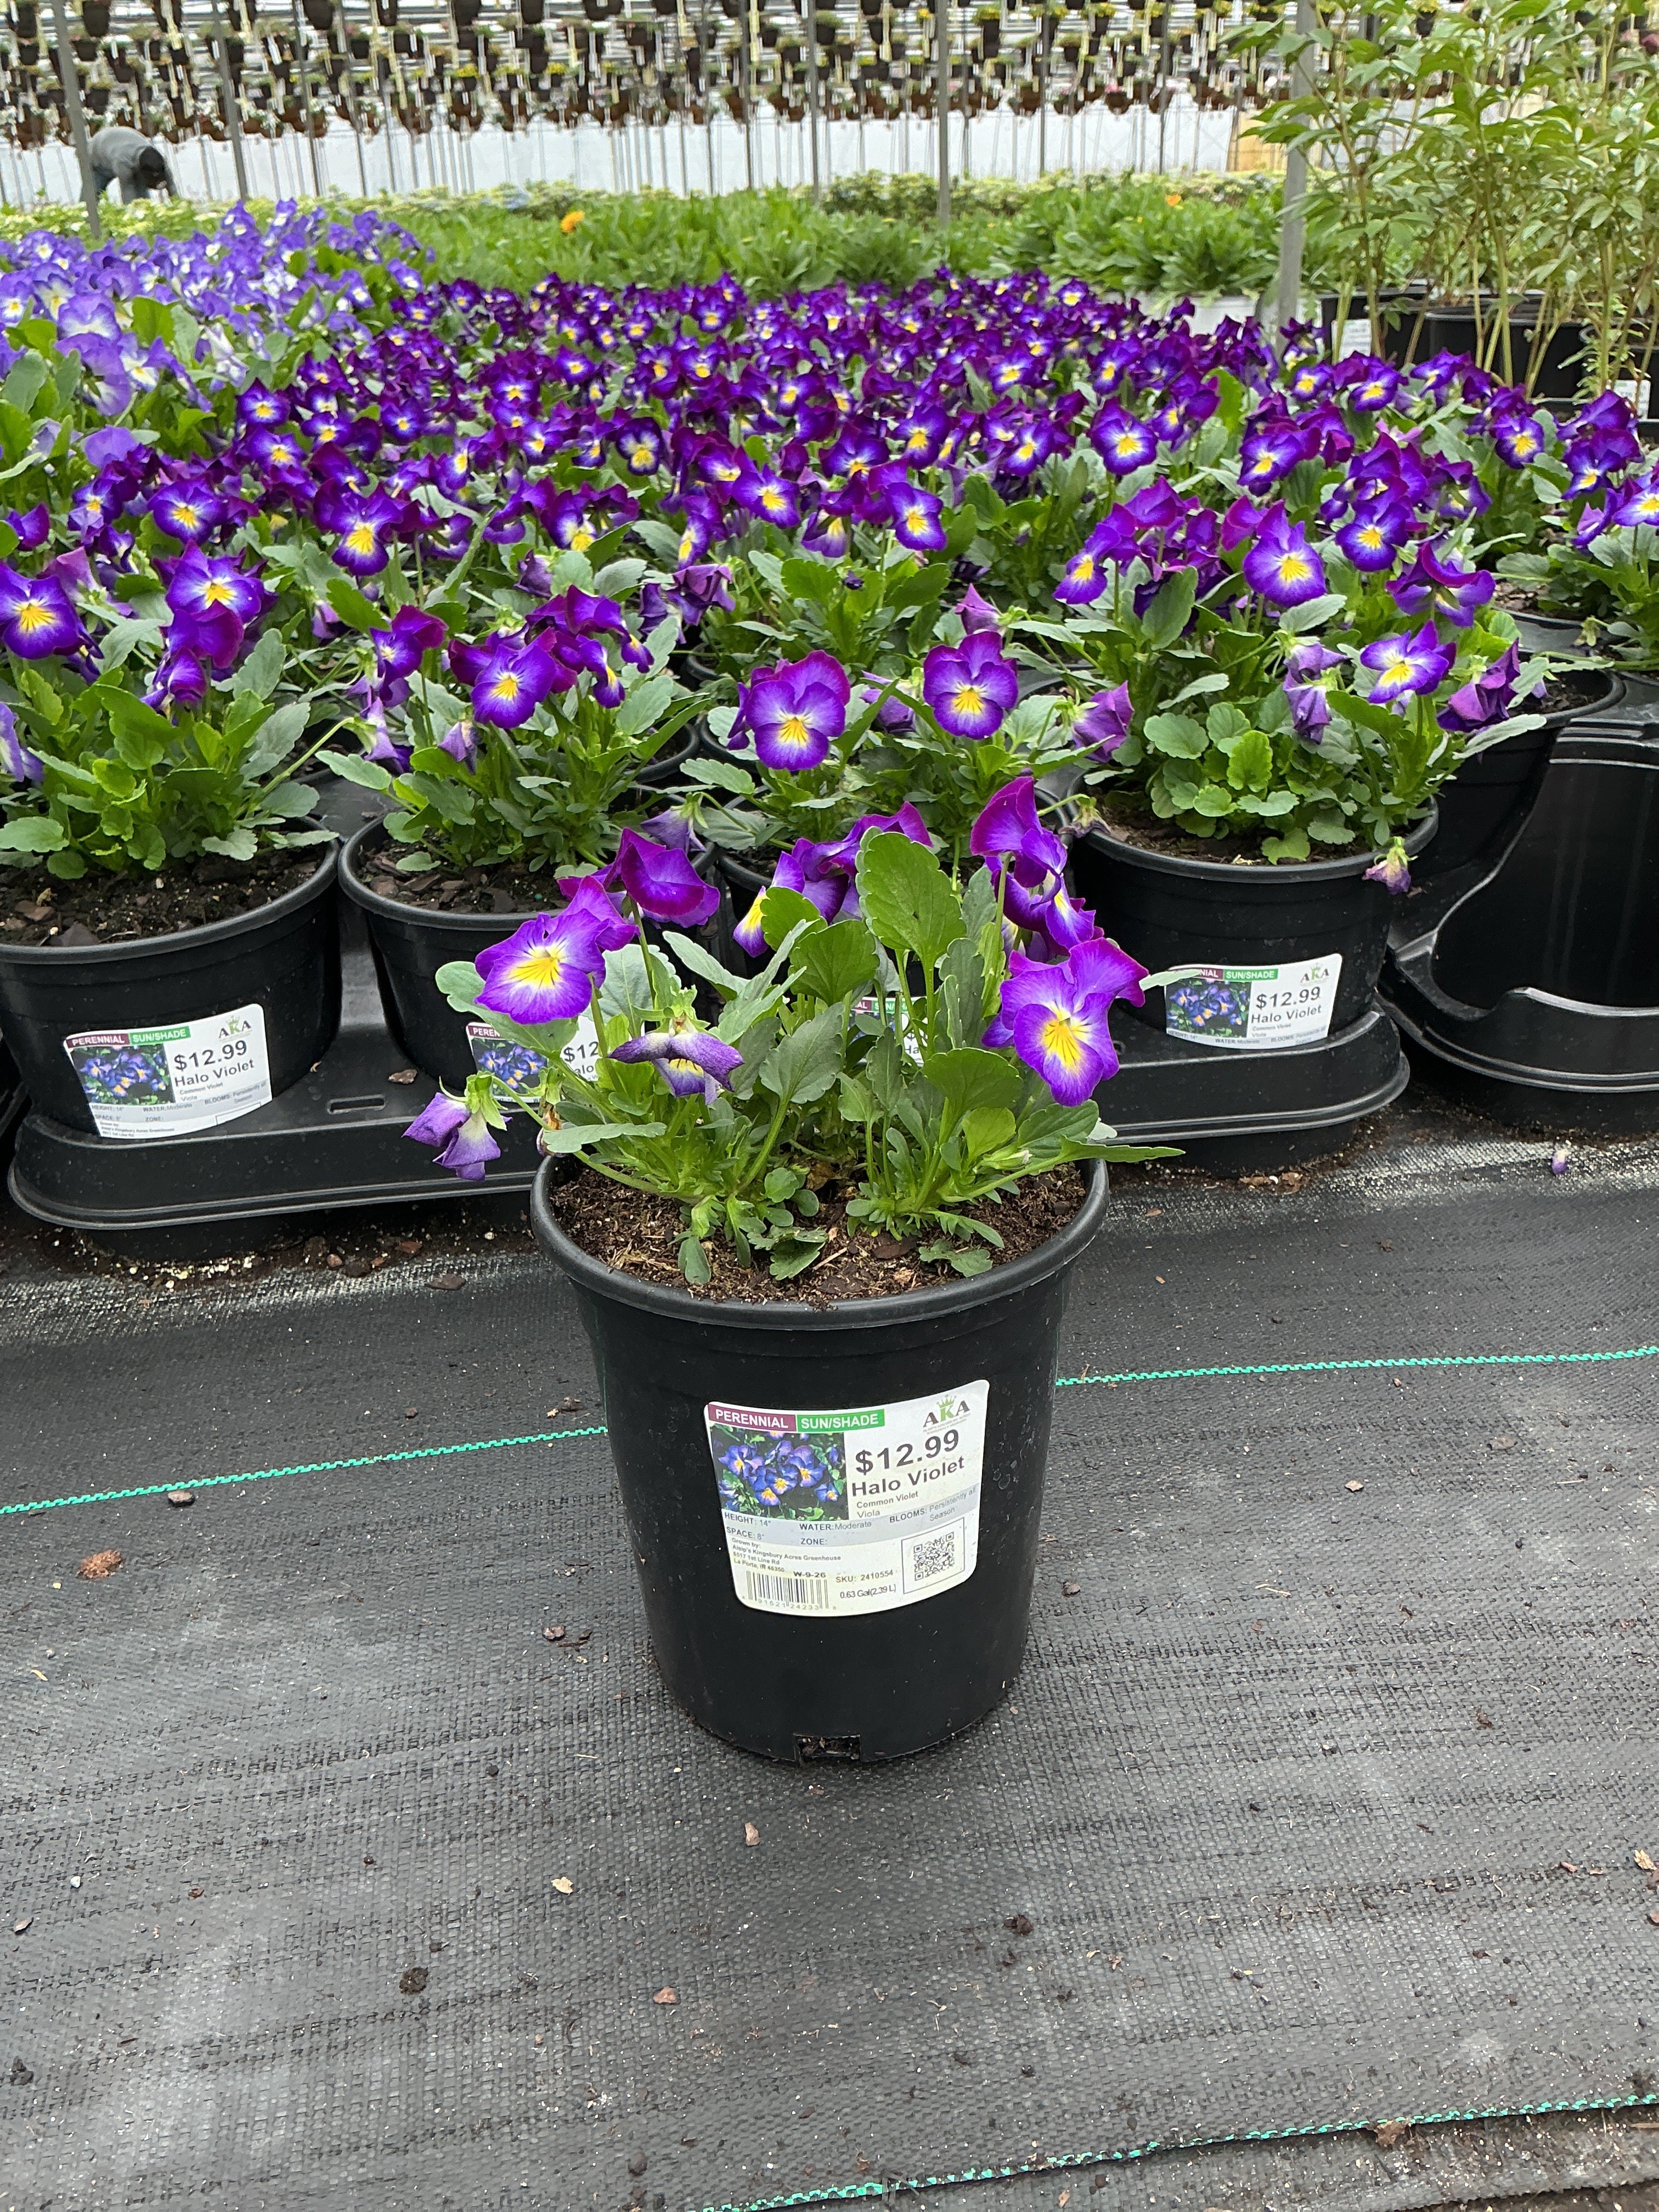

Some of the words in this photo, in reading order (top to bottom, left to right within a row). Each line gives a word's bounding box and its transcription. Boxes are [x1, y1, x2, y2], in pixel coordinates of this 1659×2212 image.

[1226, 971, 1274, 980] SUN/SHADE
[1300, 968, 1329, 984] AKA
[1255, 986, 1321, 1011] $12.99
[1251, 1013, 1282, 1024] Halo
[1286, 1006, 1322, 1020] Violet
[72, 1035, 125, 1046] PERENNIAL
[132, 1029, 187, 1042] SUN/SHADE
[218, 1020, 252, 1039] AKA
[473, 1027, 500, 1037] PEREN
[174, 1040, 247, 1071] $12.99
[563, 1042, 599, 1063] $12
[174, 1074, 209, 1087] Halo
[213, 1059, 255, 1079] Violet
[575, 1064, 594, 1076] alo
[179, 1086, 206, 1095] Common
[207, 1082, 223, 1090] Violet
[715, 1409, 789, 1429] PERENNIAL
[801, 1413, 879, 1429] SUN/SHADE
[923, 1400, 970, 1427] AKA
[855, 1429, 959, 1476] $12.99
[852, 1479, 901, 1497] Halo
[907, 1455, 964, 1486] Violet
[856, 1497, 894, 1509] Common
[896, 1491, 919, 1502] Violet
[889, 1509, 927, 1523] BLOOMS:
[929, 1491, 967, 1512] Persistently
[725, 1512, 757, 1525] HEIGHT:
[857, 1509, 881, 1519] Viola
[930, 1507, 955, 1522] Season
[726, 1527, 756, 1539] SPACE:
[732, 1537, 751, 1546] Grown
[753, 1549, 783, 1560] Kingsbury
[860, 1569, 893, 1581] 2410554
[840, 1590, 856, 1599] 0.63
